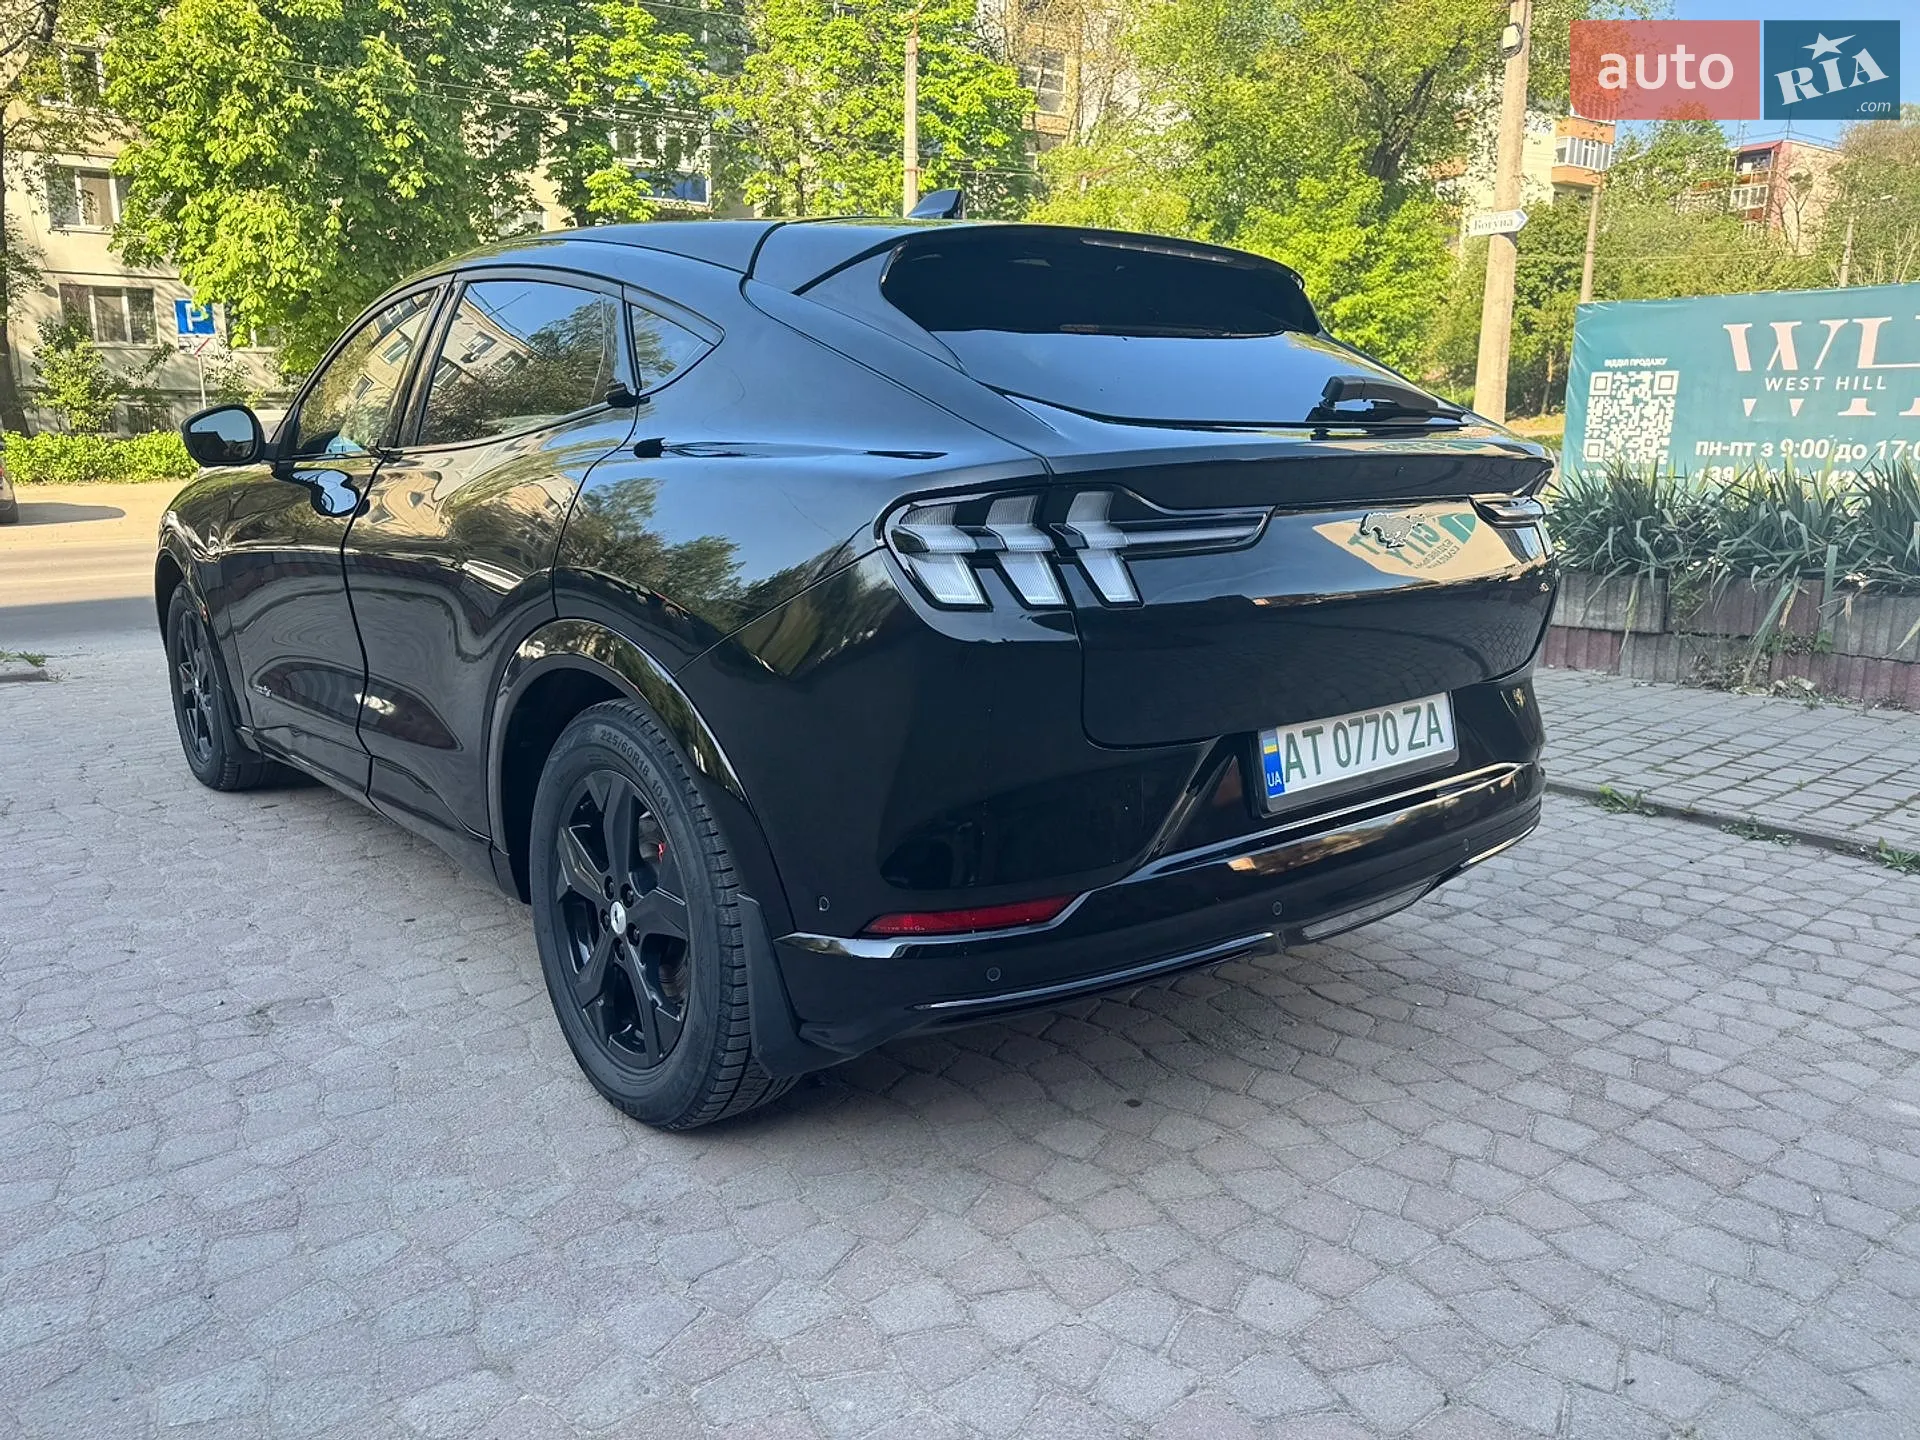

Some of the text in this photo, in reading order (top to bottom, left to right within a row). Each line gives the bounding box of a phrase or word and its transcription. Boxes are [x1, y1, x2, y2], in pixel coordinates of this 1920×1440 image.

[1765, 375, 1887, 392] WEST HILL
[1695, 440, 1756, 458] пн-пт
[1780, 438, 1829, 460] 9:00
[1832, 443, 1868, 463] до
[1285, 701, 1444, 783] AT 0770 ZA
[1266, 772, 1282, 787] UA
